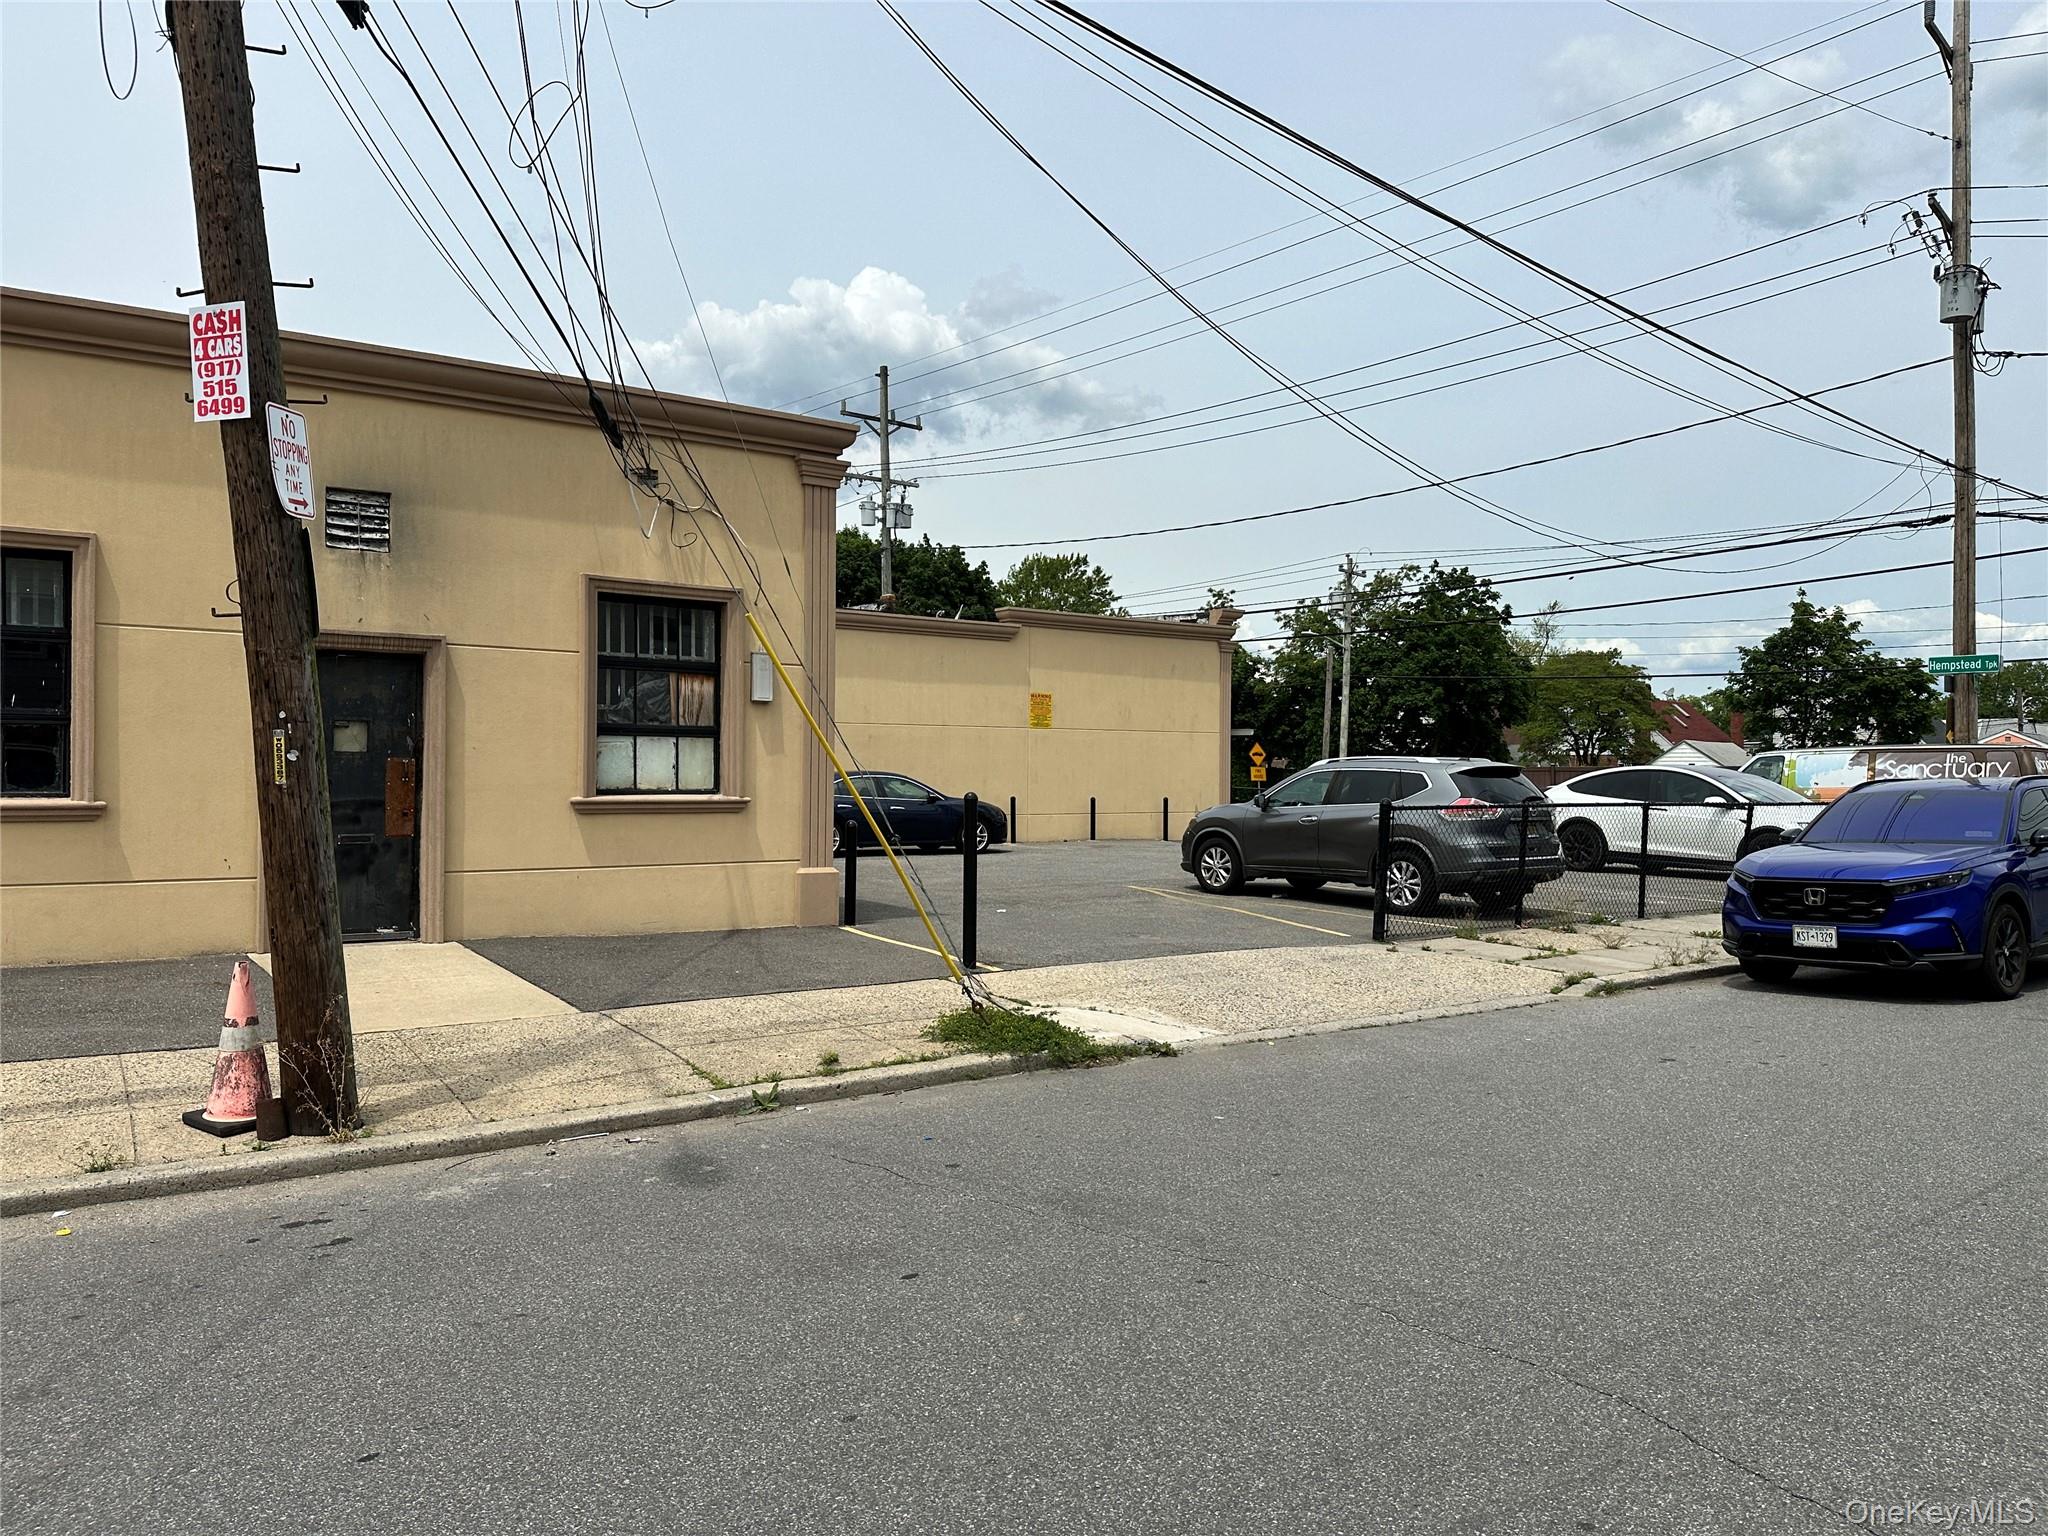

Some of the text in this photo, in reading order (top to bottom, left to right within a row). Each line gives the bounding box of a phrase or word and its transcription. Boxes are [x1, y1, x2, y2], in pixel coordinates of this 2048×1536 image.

[195, 340, 204, 358] 4
[197, 359, 242, 379] (917)
[203, 378, 238, 398] 515
[197, 396, 245, 417] 6499
[280, 416, 296, 439] NO
[273, 437, 308, 465] STOPPING
[285, 463, 300, 479] ANY
[285, 478, 304, 495] TIME
[1929, 659, 1998, 672] Hempstead Tpk
[1884, 755, 2011, 779] Sanctuary
[1946, 752, 1967, 763] the
